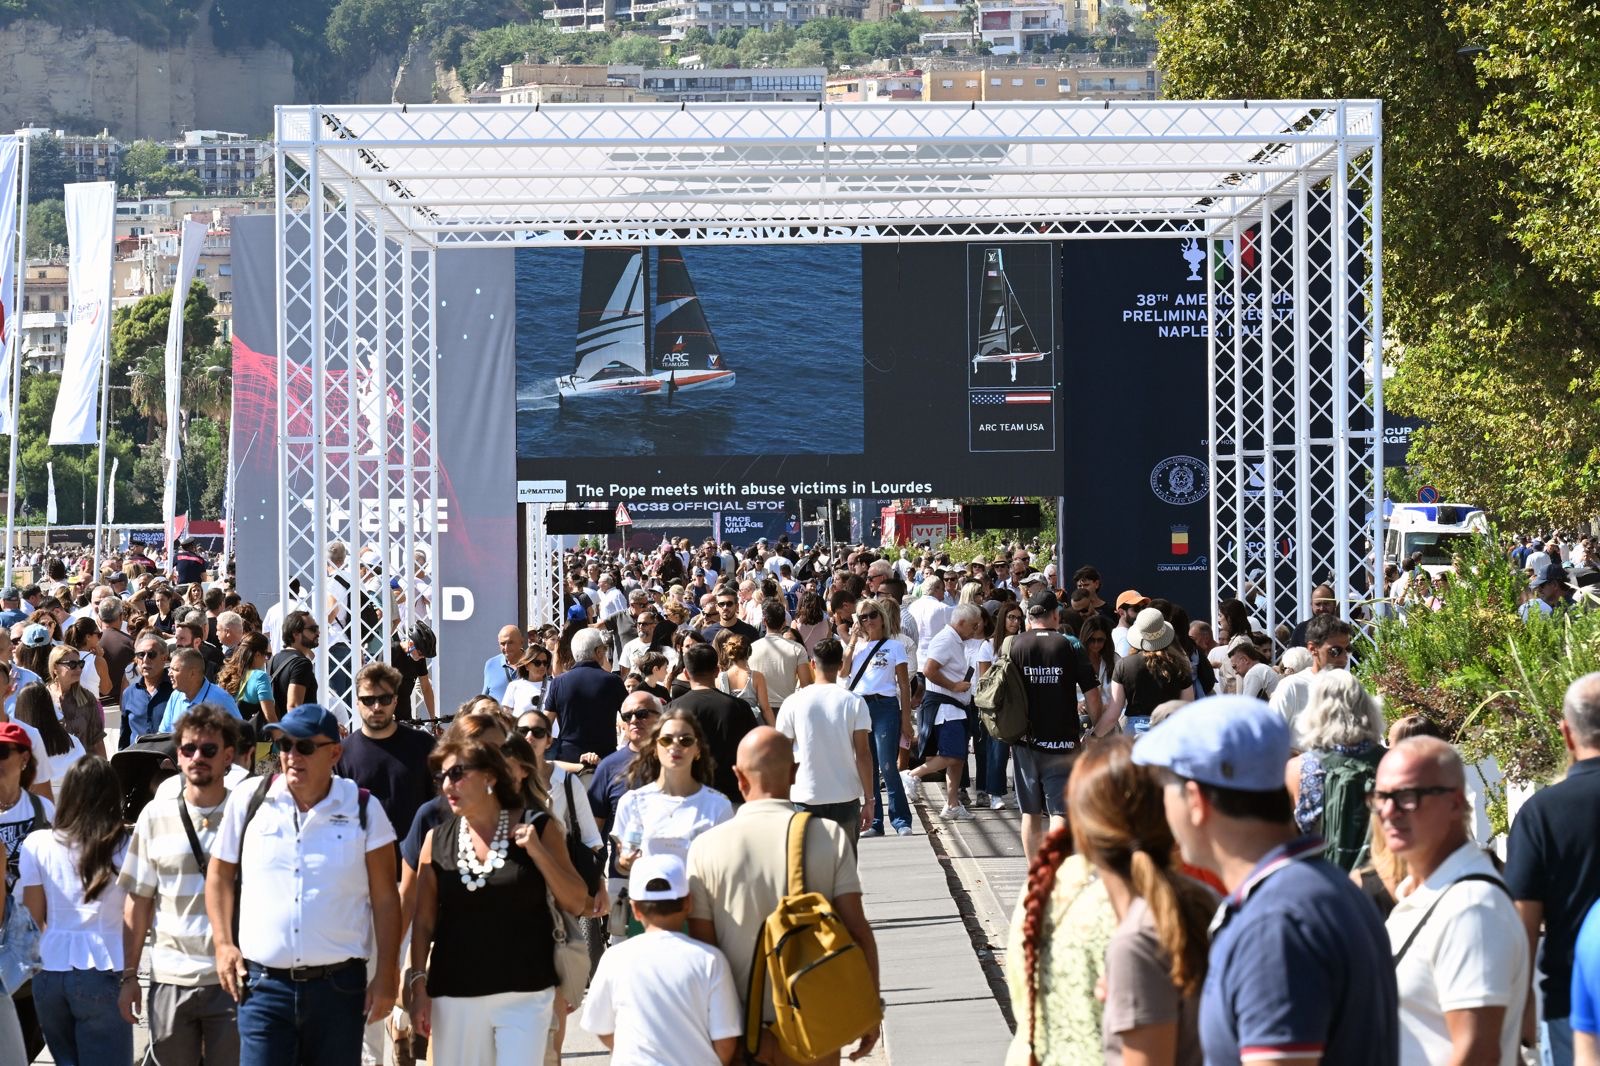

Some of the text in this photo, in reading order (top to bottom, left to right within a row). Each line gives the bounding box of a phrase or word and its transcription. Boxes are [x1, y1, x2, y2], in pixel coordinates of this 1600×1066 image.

[1136, 294, 1169, 306] 38TH
[662, 353, 690, 362] ARC
[1385, 427, 1412, 435] CUP
[576, 481, 932, 498] The Pope meets with abuse victims in Lourdes
[672, 501, 743, 512] OFFICIAL
[916, 528, 943, 536] VVF
[1024, 666, 1063, 676] Emirates
[1039, 675, 1059, 683] BETTER
